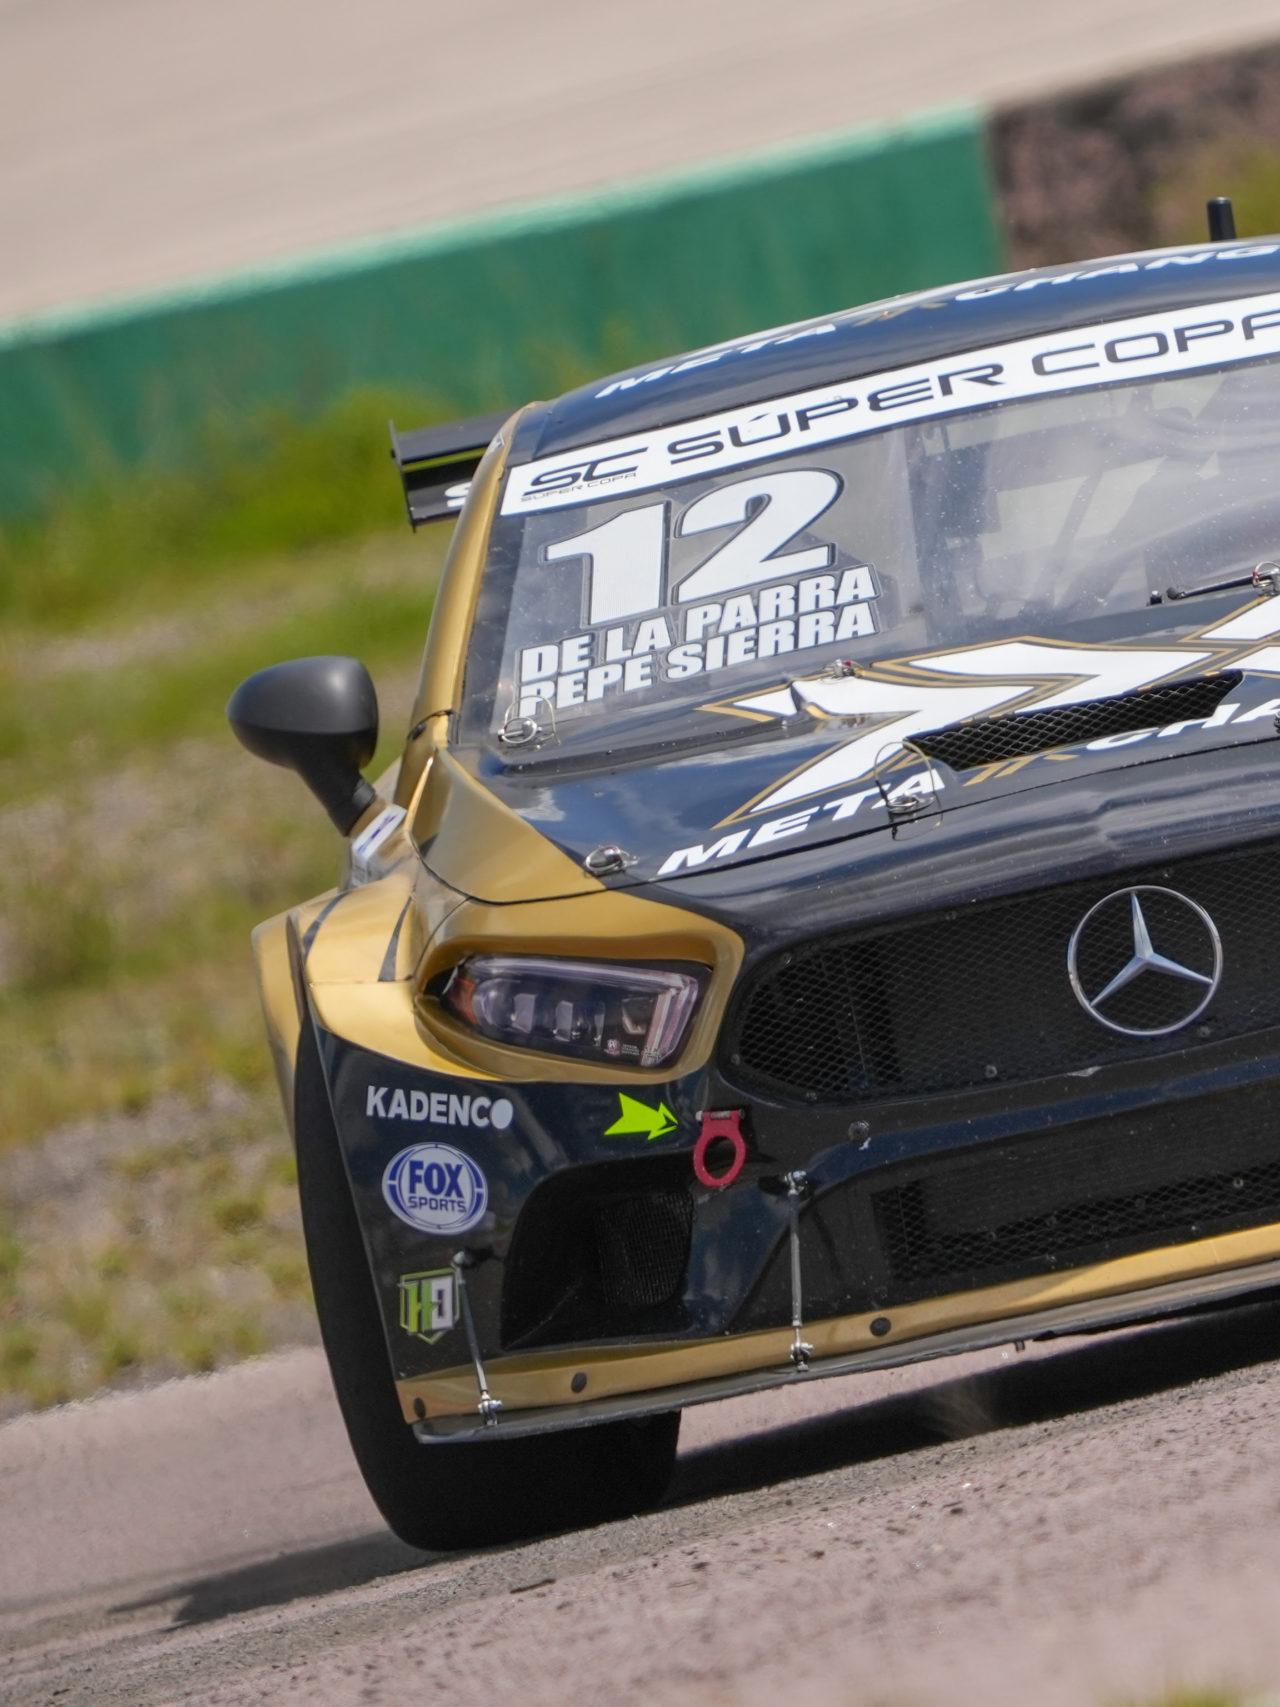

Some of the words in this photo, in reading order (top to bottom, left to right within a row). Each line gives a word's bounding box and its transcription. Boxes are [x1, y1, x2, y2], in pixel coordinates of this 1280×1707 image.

[667, 362, 1005, 465] SÚPER
[542, 468, 840, 627] 12
[519, 654, 653, 719] PEPE
[667, 602, 877, 679] SIERRA
[520, 633, 594, 683] DE
[605, 616, 673, 663] LA
[685, 564, 877, 643] PARRA
[656, 768, 946, 876] META
[407, 1196, 468, 1214] SPORTS
[408, 1159, 465, 1199] FOX
